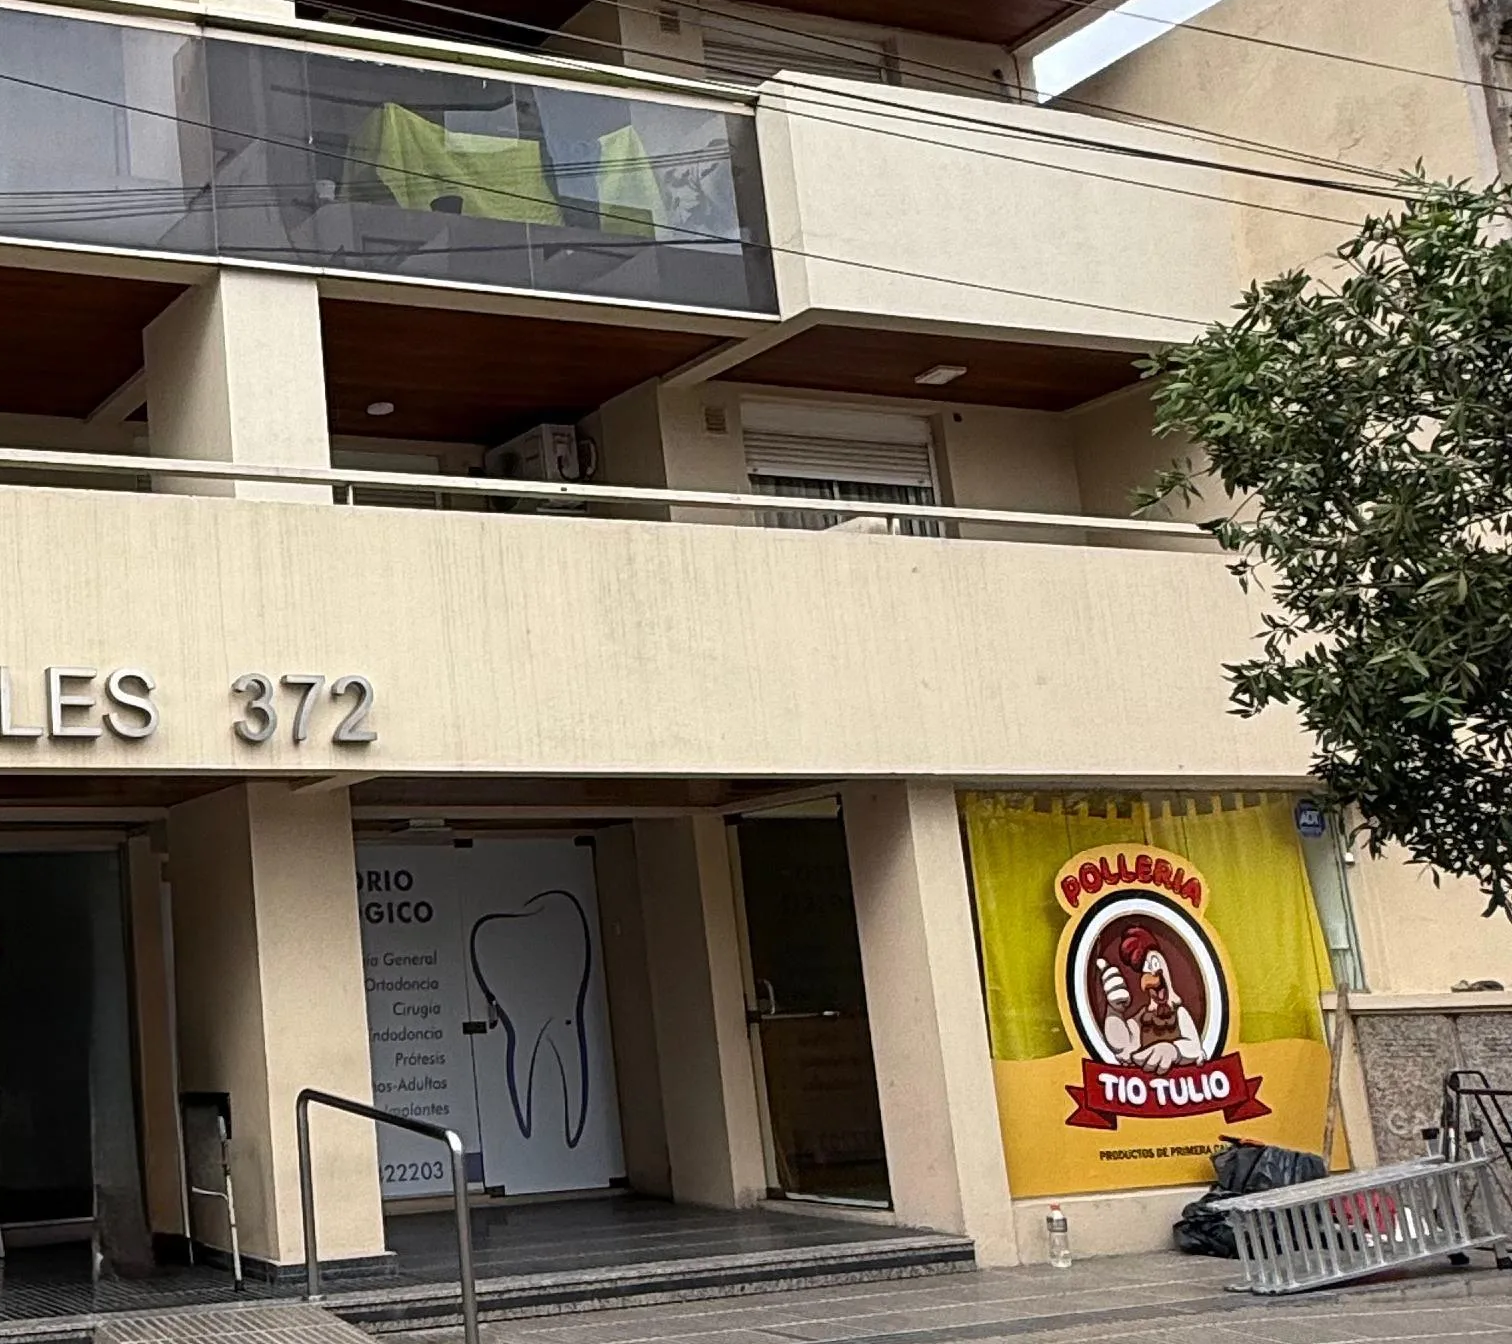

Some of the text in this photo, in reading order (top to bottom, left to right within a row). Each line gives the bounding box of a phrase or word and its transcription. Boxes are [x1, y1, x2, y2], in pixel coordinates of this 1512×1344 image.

[233, 673, 377, 743] 372
[1061, 853, 1202, 908] POLLERIA
[359, 901, 434, 925] GICO
[383, 949, 437, 966] General
[369, 1026, 443, 1043] ndodoncia
[1098, 1071, 1230, 1105] TIO TULIO
[1099, 1148, 1155, 1161] PRODUCTOS
[1156, 1147, 1169, 1158] DE
[1171, 1145, 1211, 1156] PRIMERA
[379, 1161, 444, 1183] 22203
